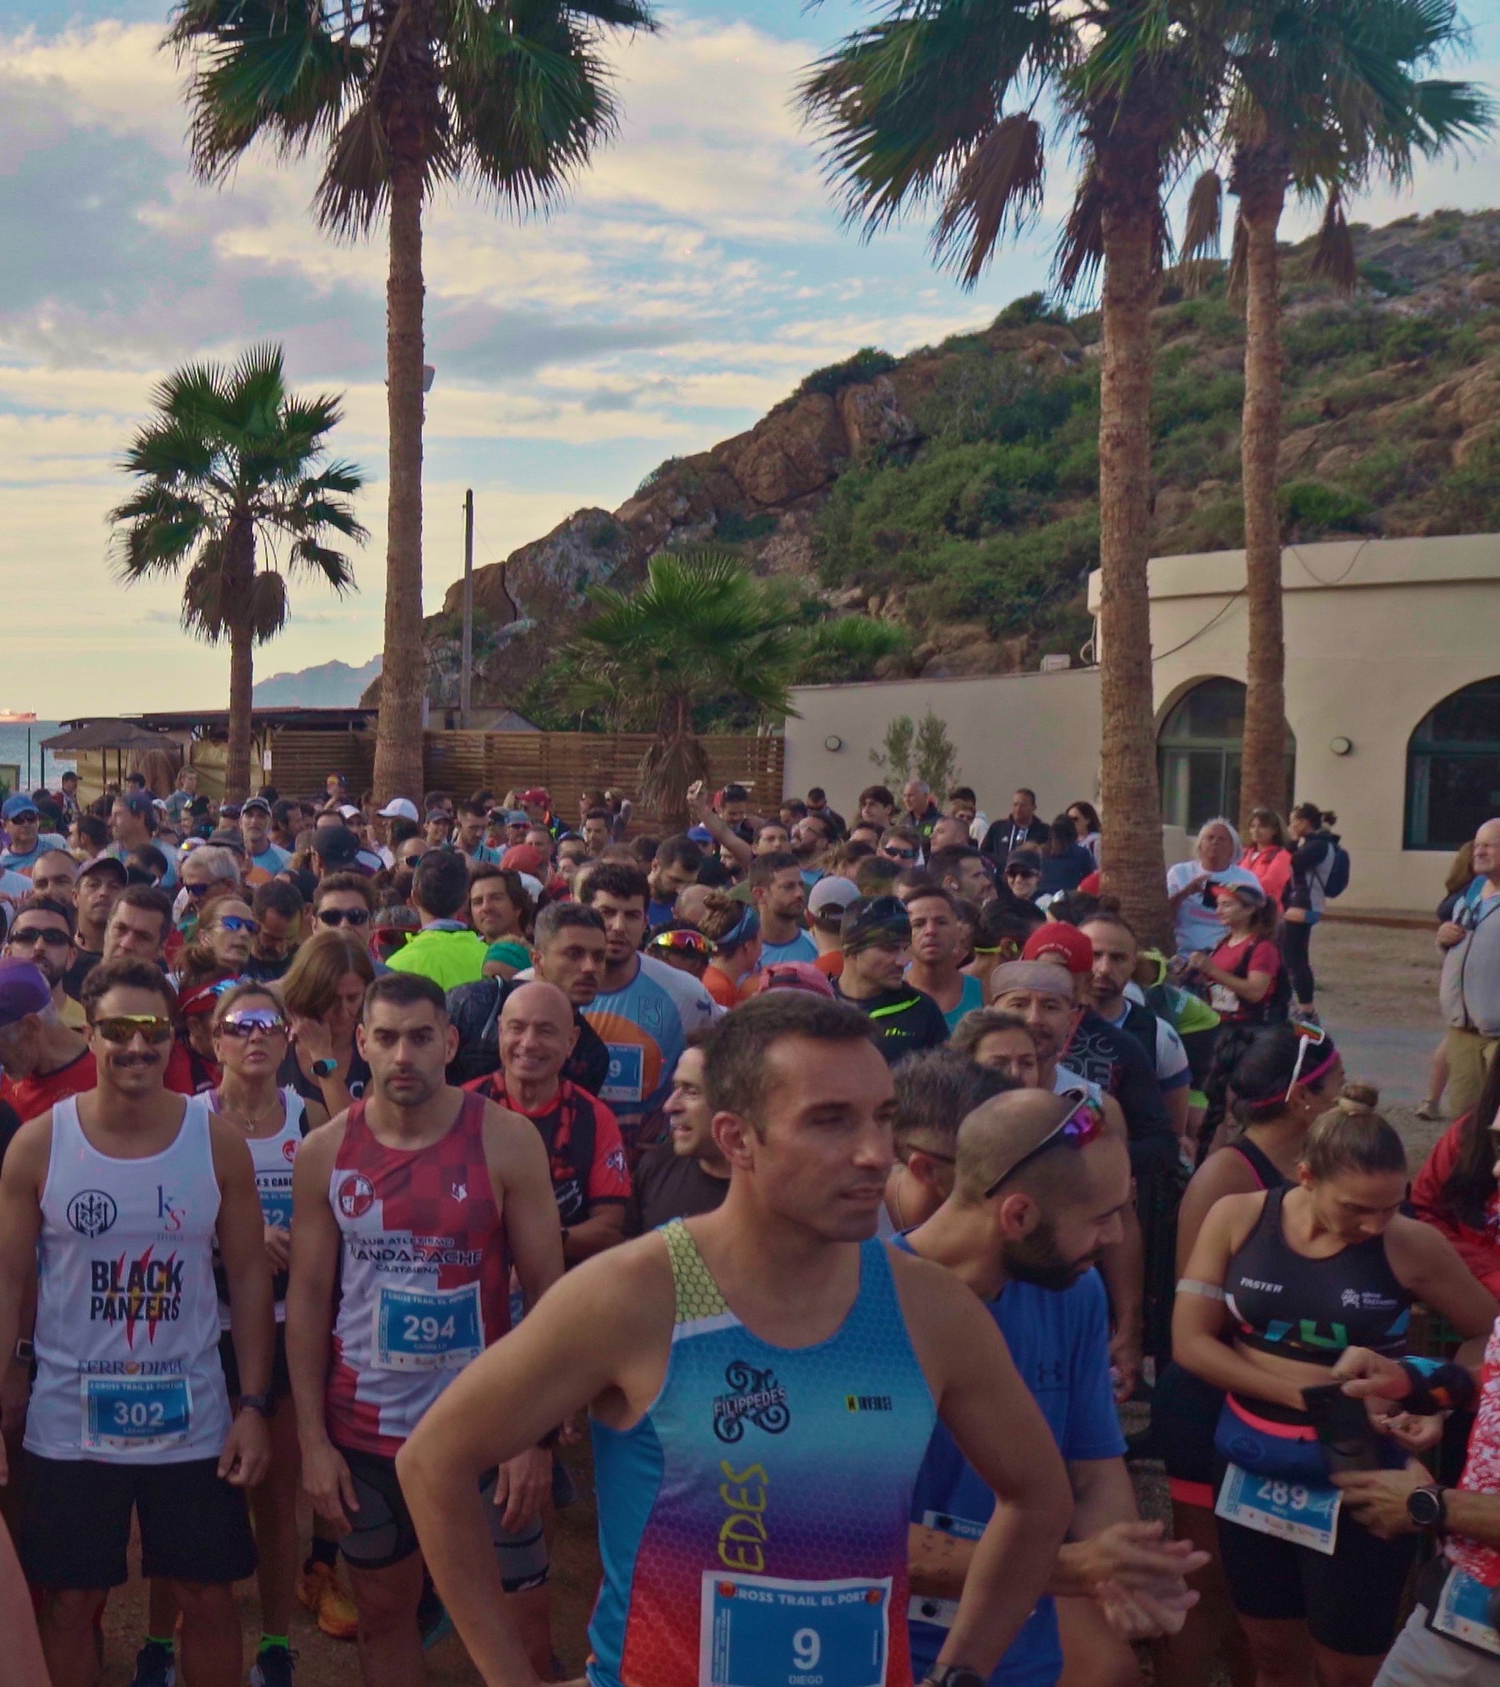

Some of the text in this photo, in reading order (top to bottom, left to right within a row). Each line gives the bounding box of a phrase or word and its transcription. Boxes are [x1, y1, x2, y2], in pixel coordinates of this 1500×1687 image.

[91, 1260, 184, 1293] BLACK
[91, 1296, 181, 1320] PANZERS
[403, 1315, 456, 1341] 294
[113, 1401, 164, 1427] 302
[713, 1387, 786, 1418] FILIPPEDES
[1257, 1477, 1309, 1510] 289
[778, 1594, 818, 1607] TRAIL
[821, 1596, 835, 1606] EL
[792, 1627, 821, 1671] 9
[788, 1674, 824, 1686] DIEGO
